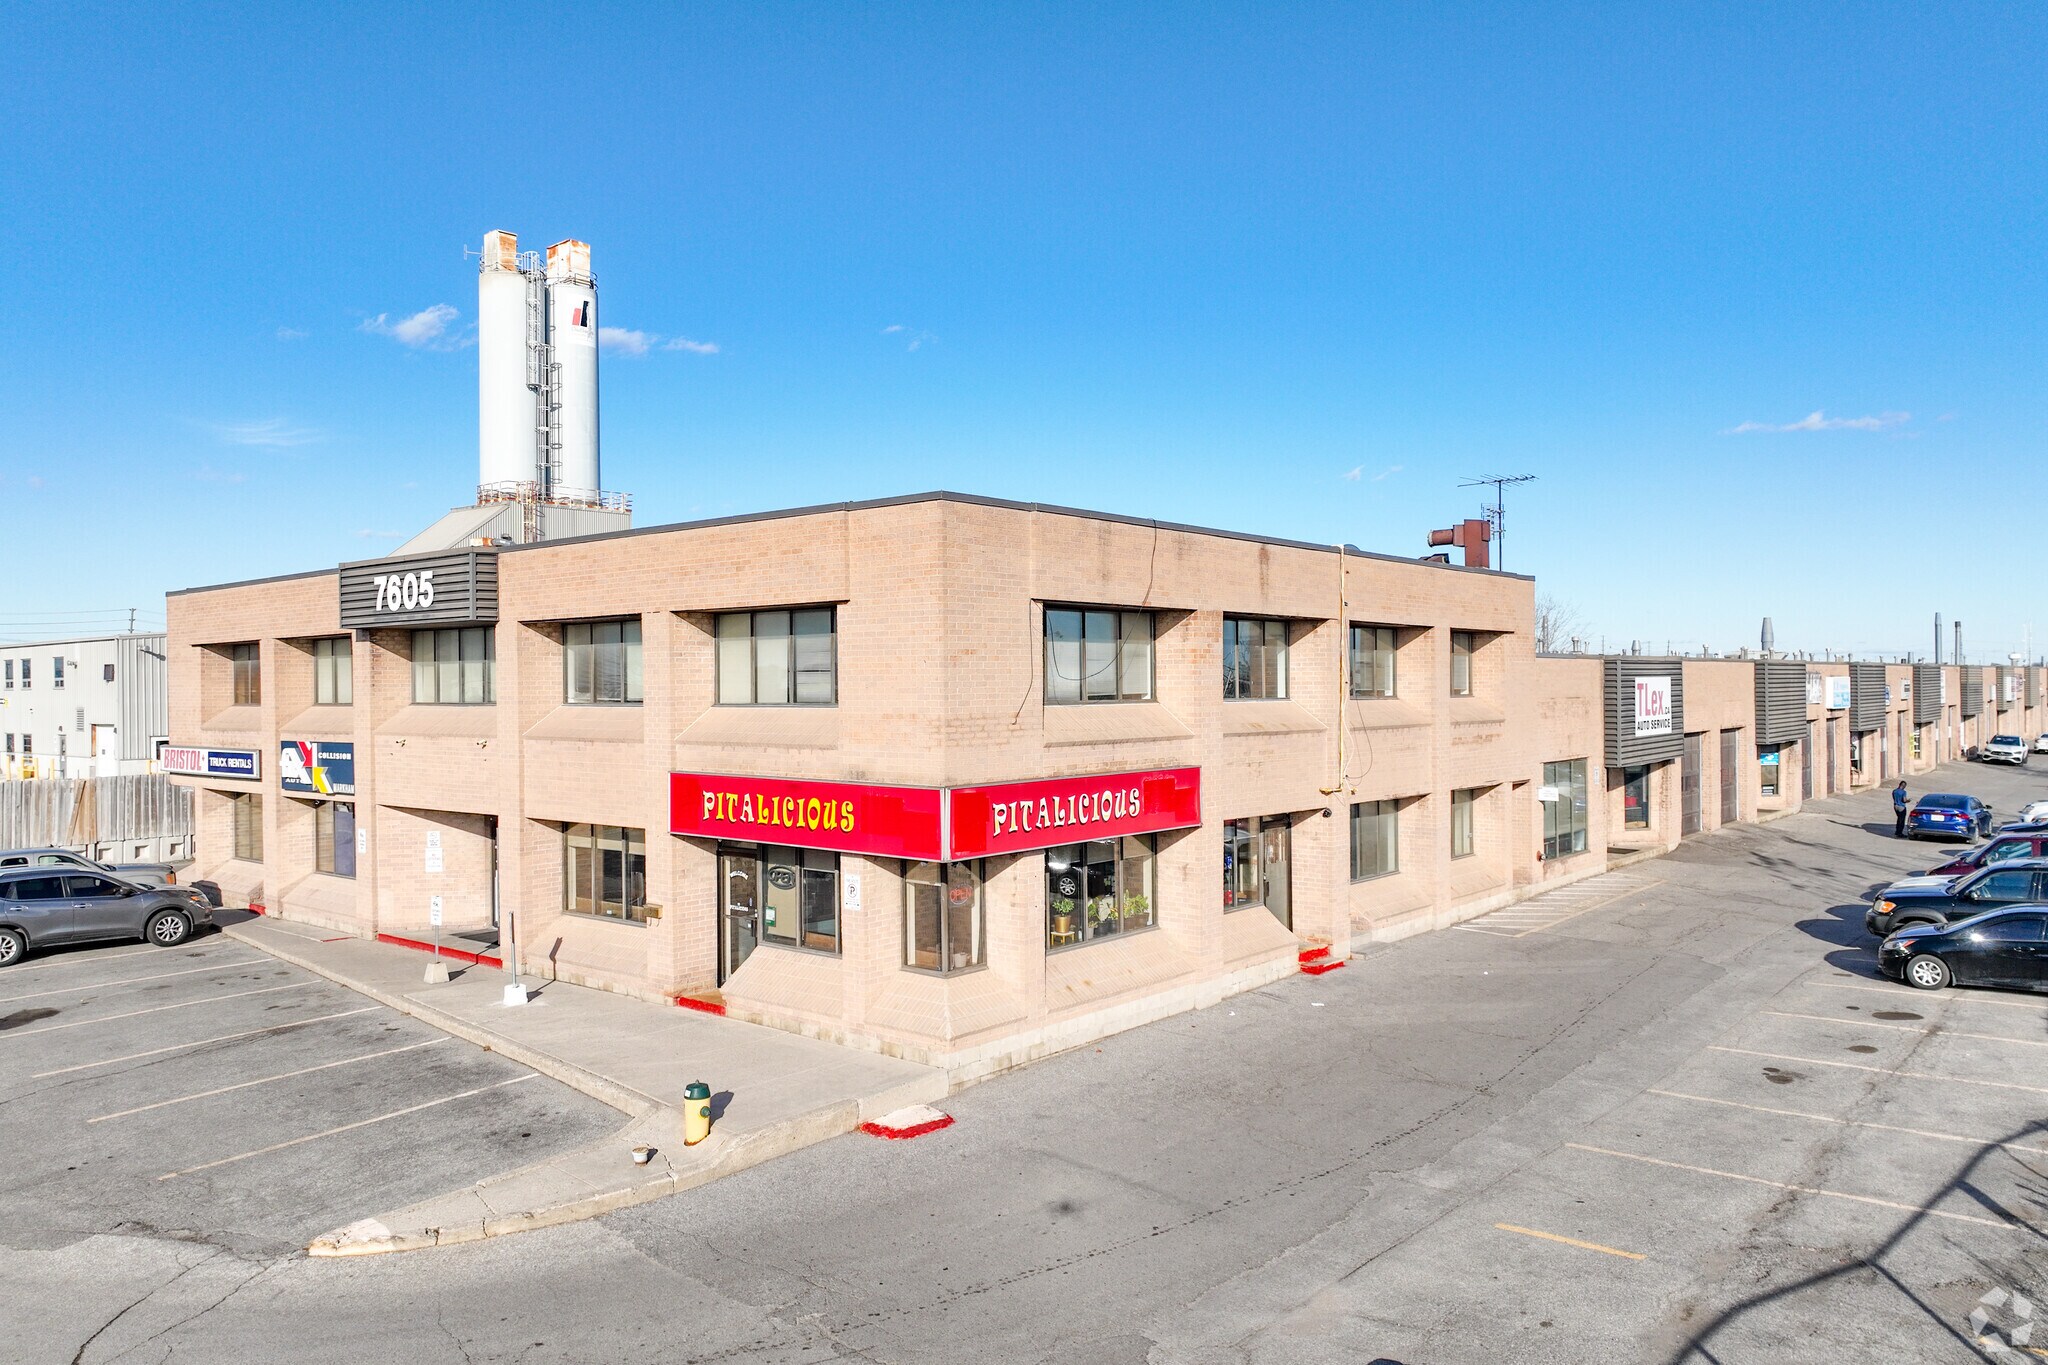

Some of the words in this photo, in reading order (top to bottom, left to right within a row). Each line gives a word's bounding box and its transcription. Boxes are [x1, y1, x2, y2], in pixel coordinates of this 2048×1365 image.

[373, 570, 434, 612] 7605
[1637, 720, 1649, 730] AUTO
[1651, 719, 1670, 729] SERVICE
[164, 749, 201, 770] BRISTOL
[209, 757, 227, 767] TRUCK
[228, 758, 251, 768] RENTALS
[318, 752, 351, 760] COLLISION
[702, 790, 854, 832] PITALICIOUS
[992, 788, 1140, 836] PITALICIOUS
[949, 887, 973, 901] OPEN
